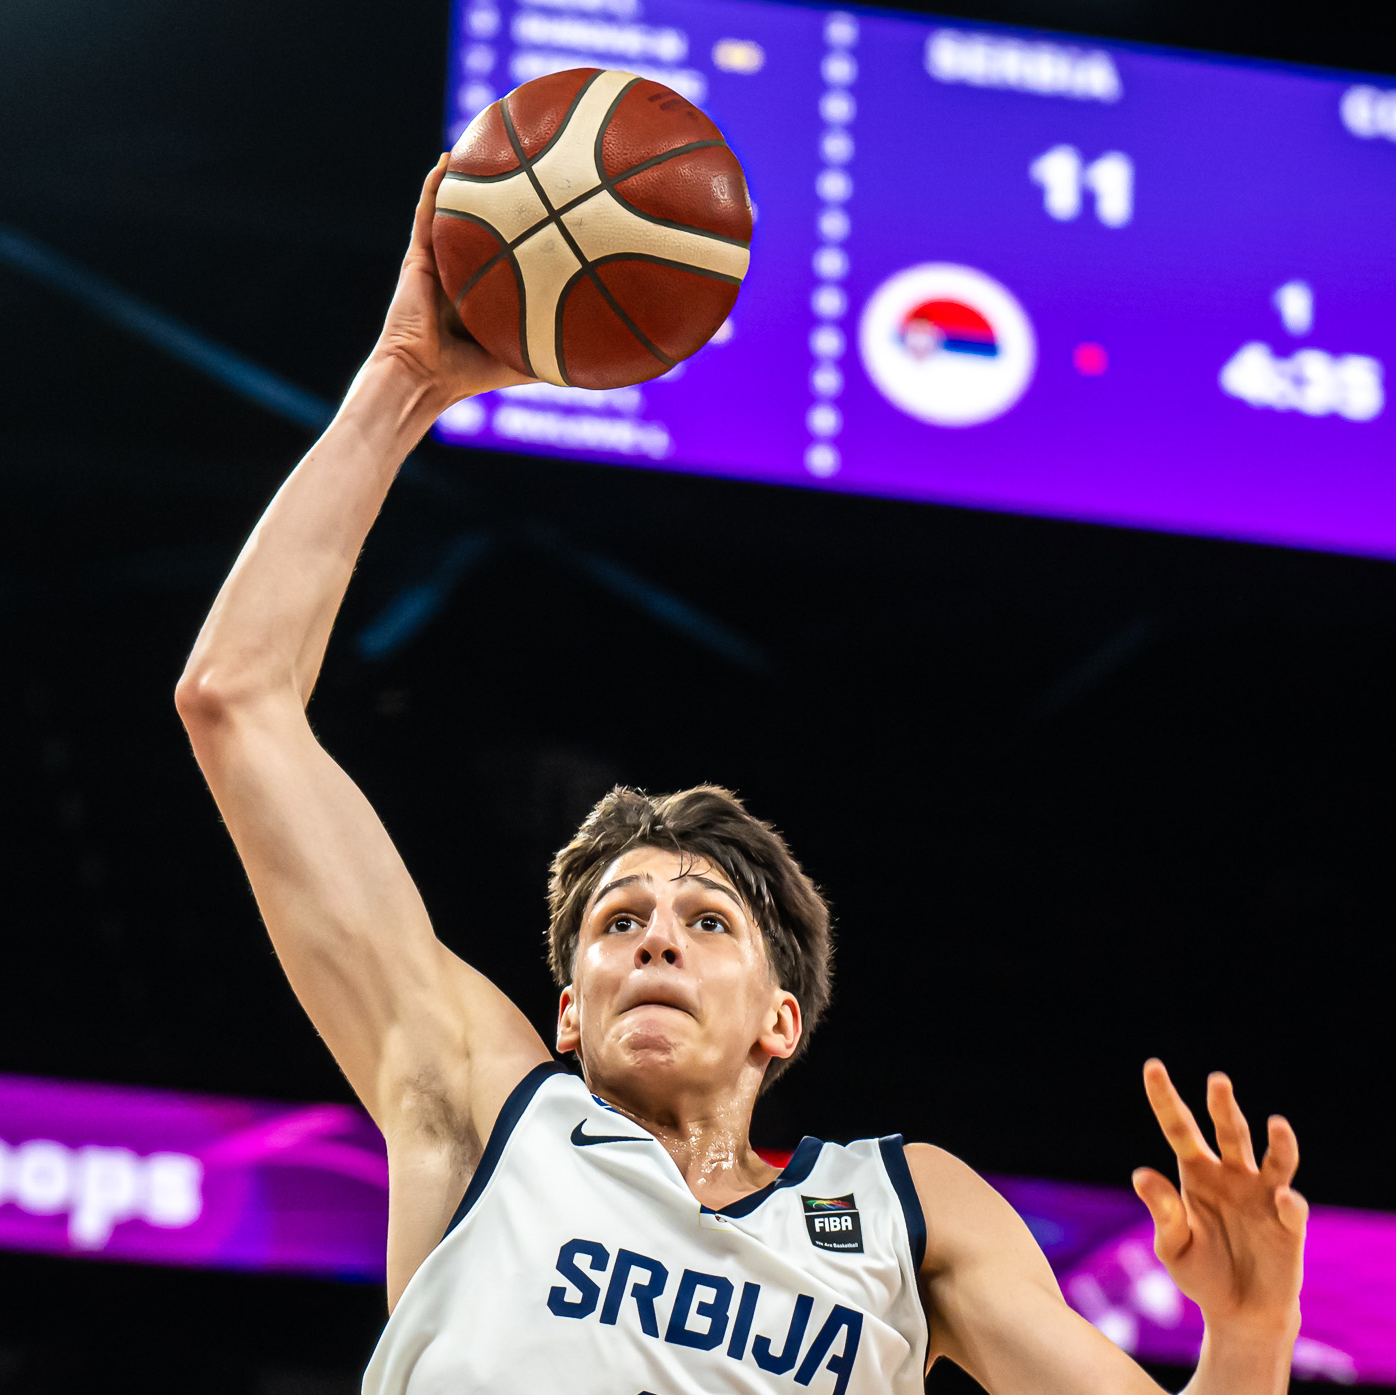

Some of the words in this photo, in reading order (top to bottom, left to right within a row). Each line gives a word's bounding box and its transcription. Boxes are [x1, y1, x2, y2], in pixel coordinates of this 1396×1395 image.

[1031, 145, 1133, 228] 11
[1274, 281, 1314, 335] 1
[814, 1216, 853, 1232] FIBA
